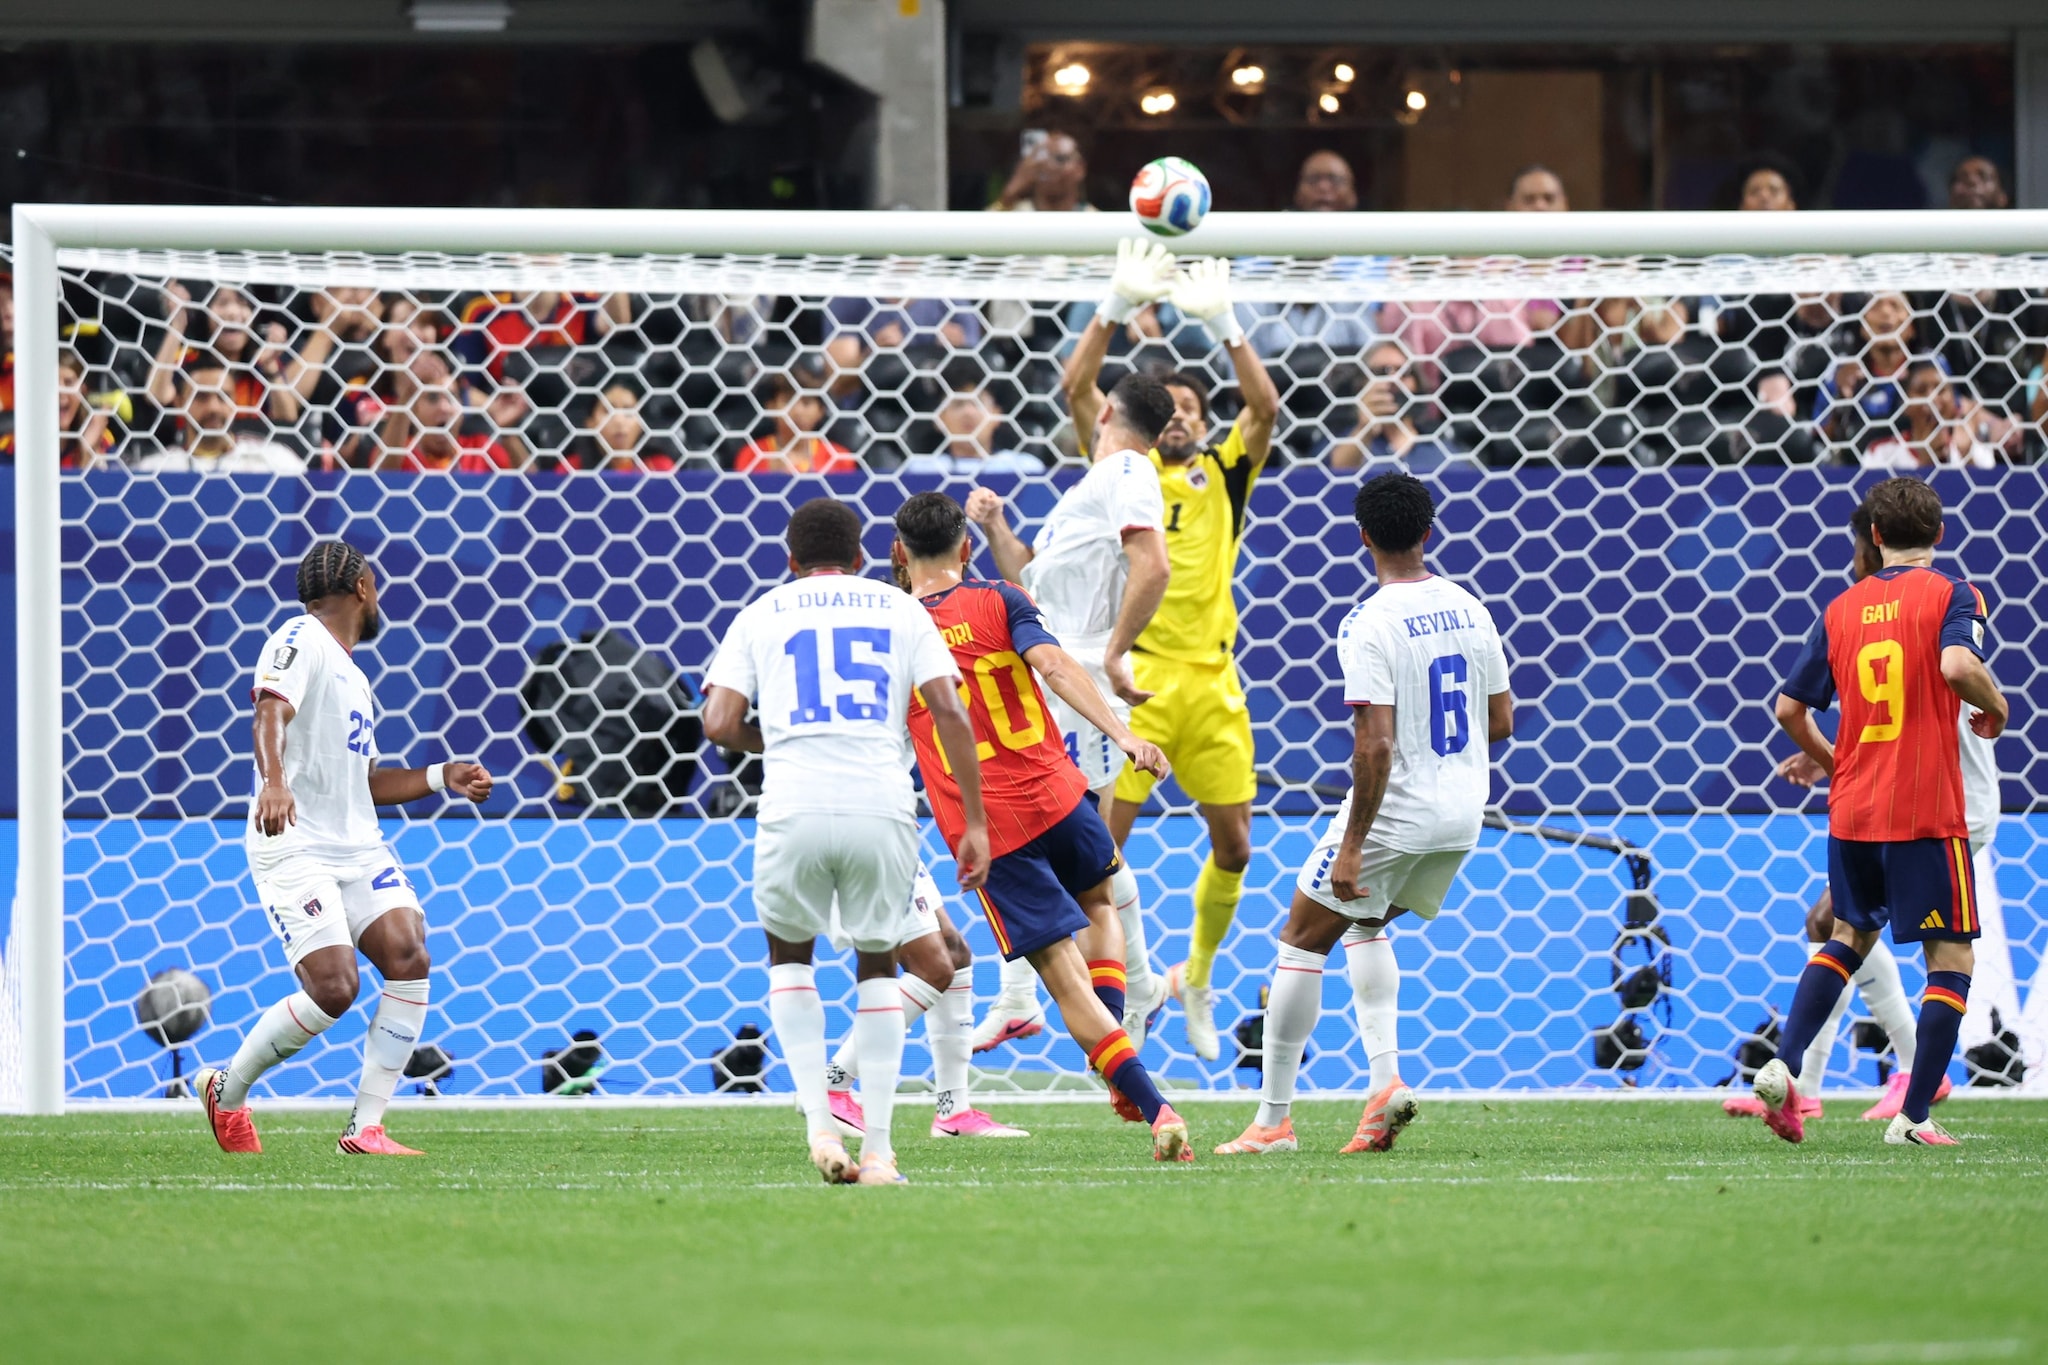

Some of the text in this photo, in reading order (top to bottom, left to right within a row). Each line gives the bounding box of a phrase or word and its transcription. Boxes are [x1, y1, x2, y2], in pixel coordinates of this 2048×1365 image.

[1166, 503, 1182, 531] 1
[798, 592, 891, 609] DUARTE
[1862, 599, 1899, 625] GAVI
[784, 626, 891, 726] 15
[1856, 639, 1904, 743] 9
[1428, 654, 1469, 757] 6
[347, 710, 373, 757] 22
